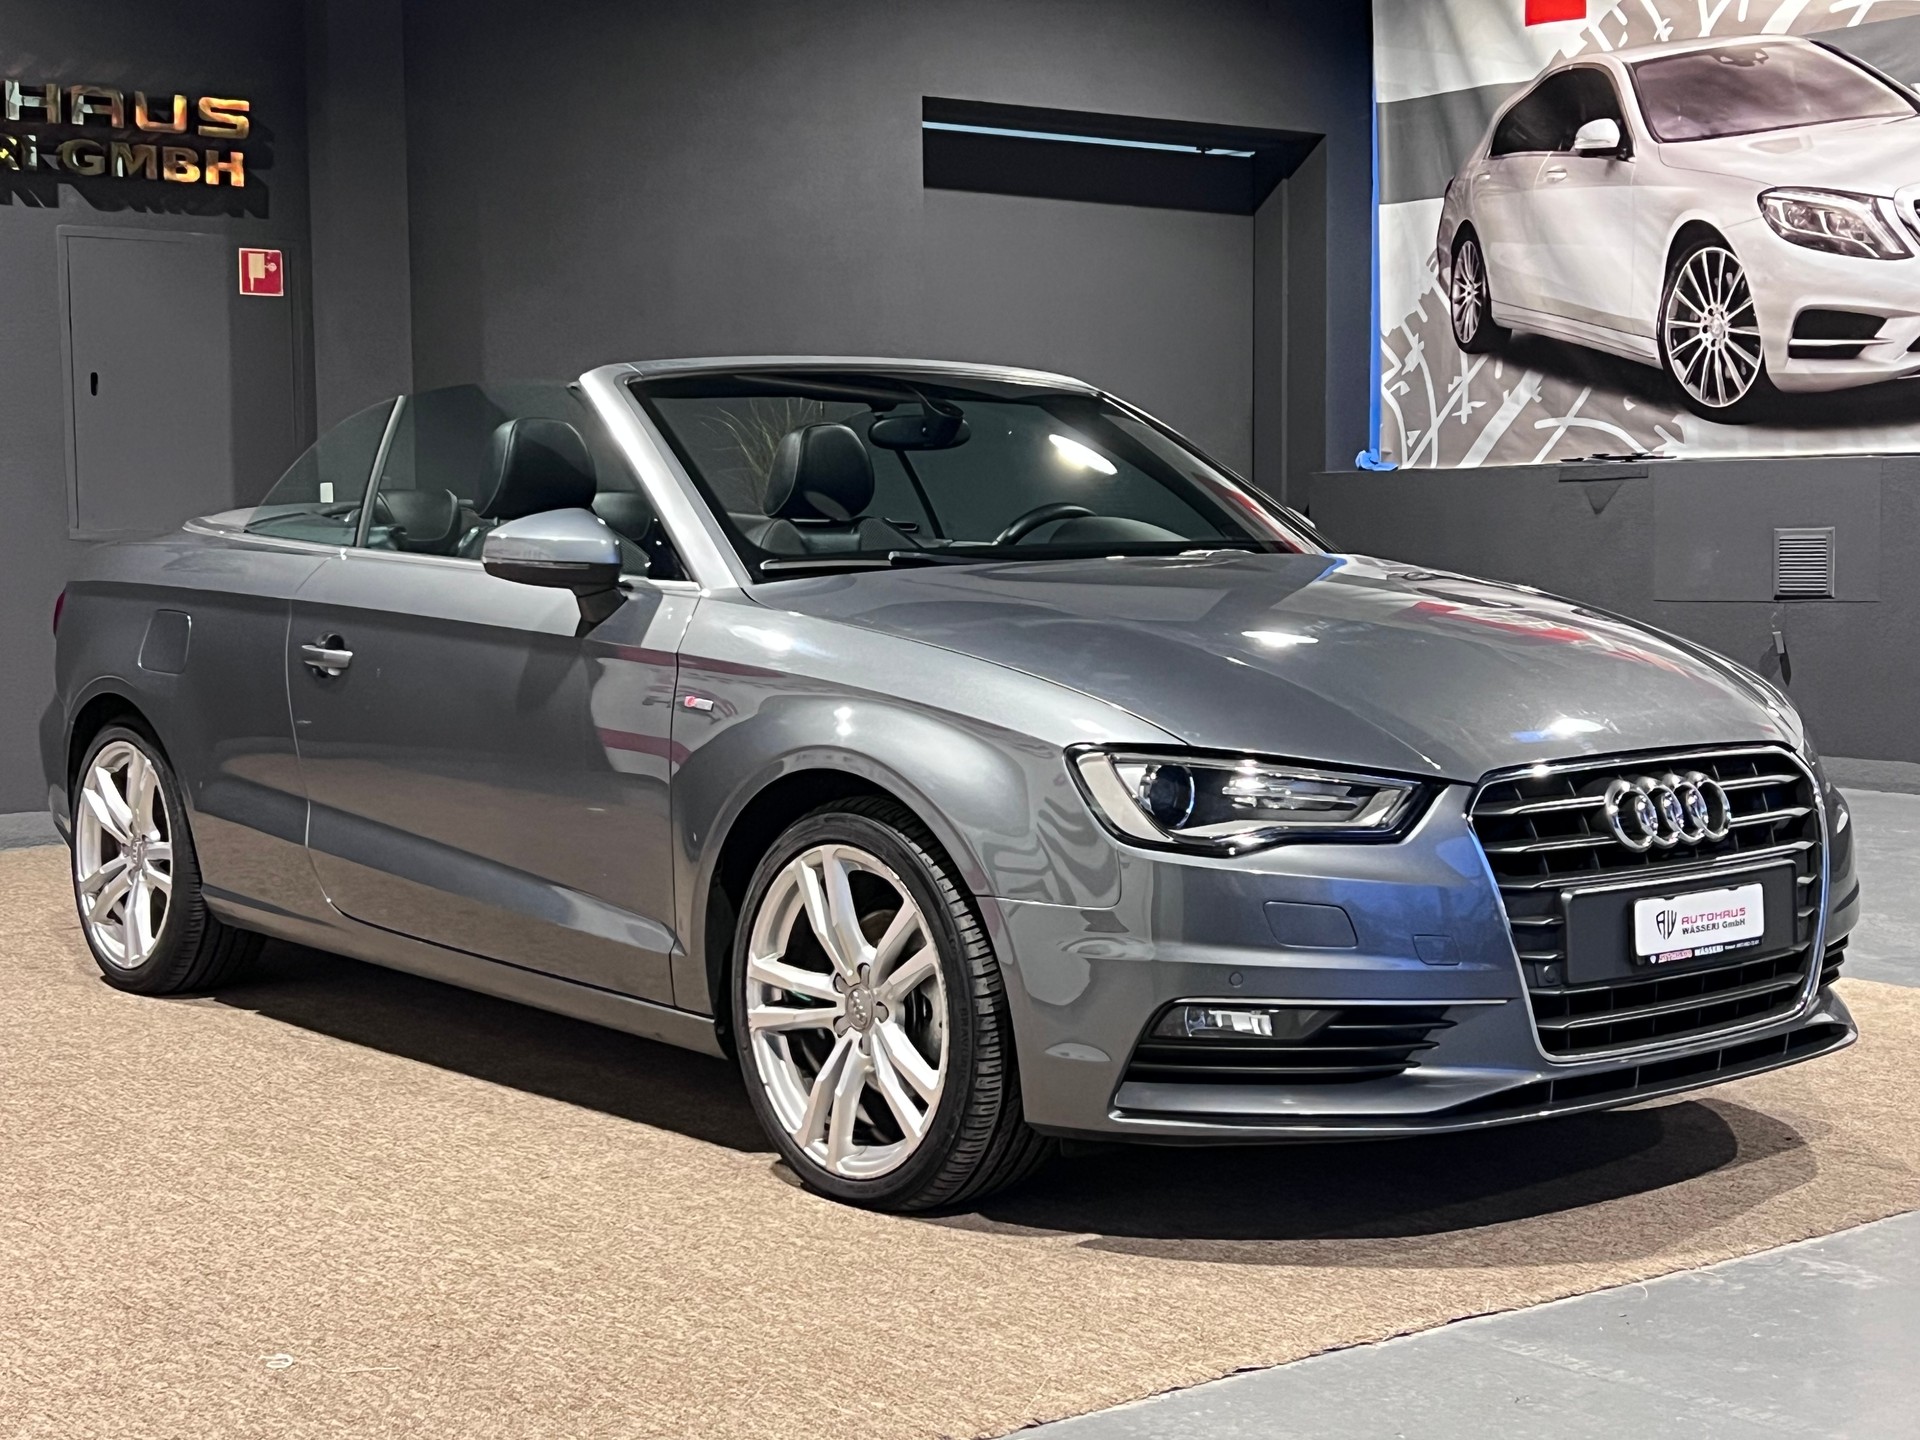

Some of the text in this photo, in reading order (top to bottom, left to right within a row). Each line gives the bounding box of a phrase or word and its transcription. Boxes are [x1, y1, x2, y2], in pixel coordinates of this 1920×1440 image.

[57, 138, 245, 188] GMBH
[1681, 907, 1746, 924] AUTOHAUS
[1721, 918, 1746, 929] GmbH
